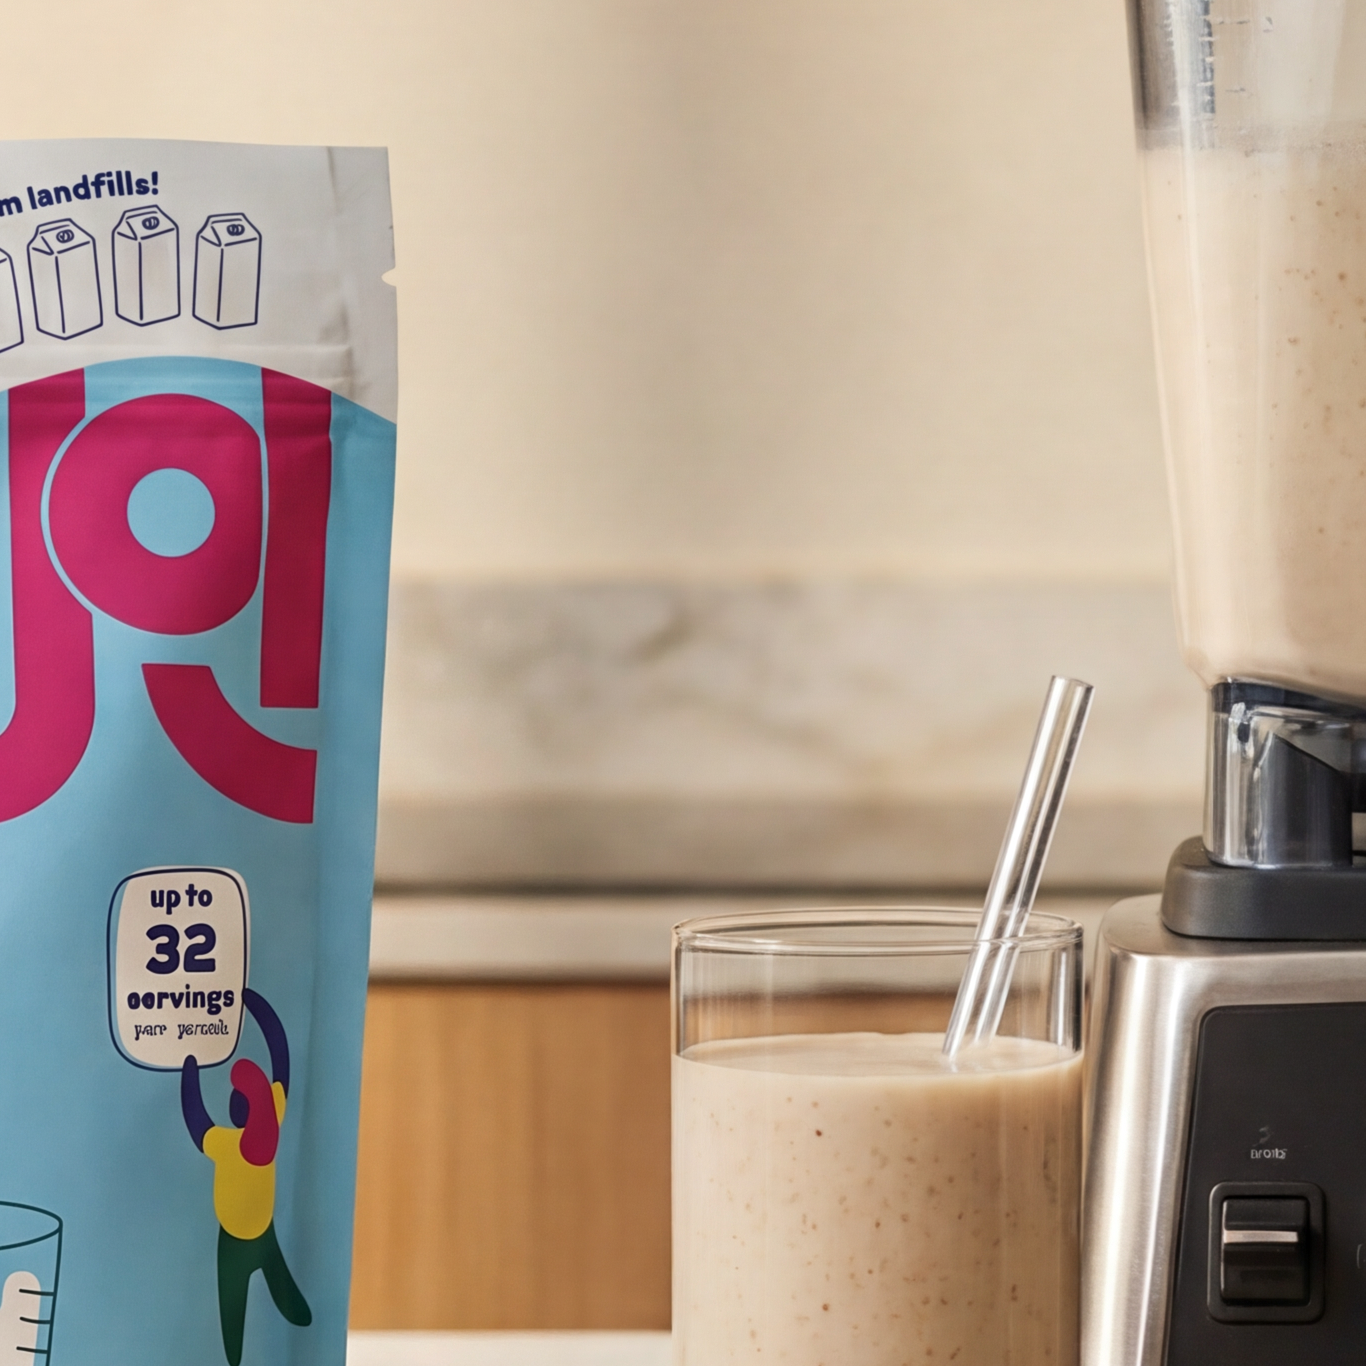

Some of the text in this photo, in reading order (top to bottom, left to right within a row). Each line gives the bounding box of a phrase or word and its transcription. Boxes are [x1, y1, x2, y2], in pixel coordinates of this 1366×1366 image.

[27, 170, 159, 210] landfills!
[150, 883, 213, 915] up to
[145, 923, 217, 975] 32
